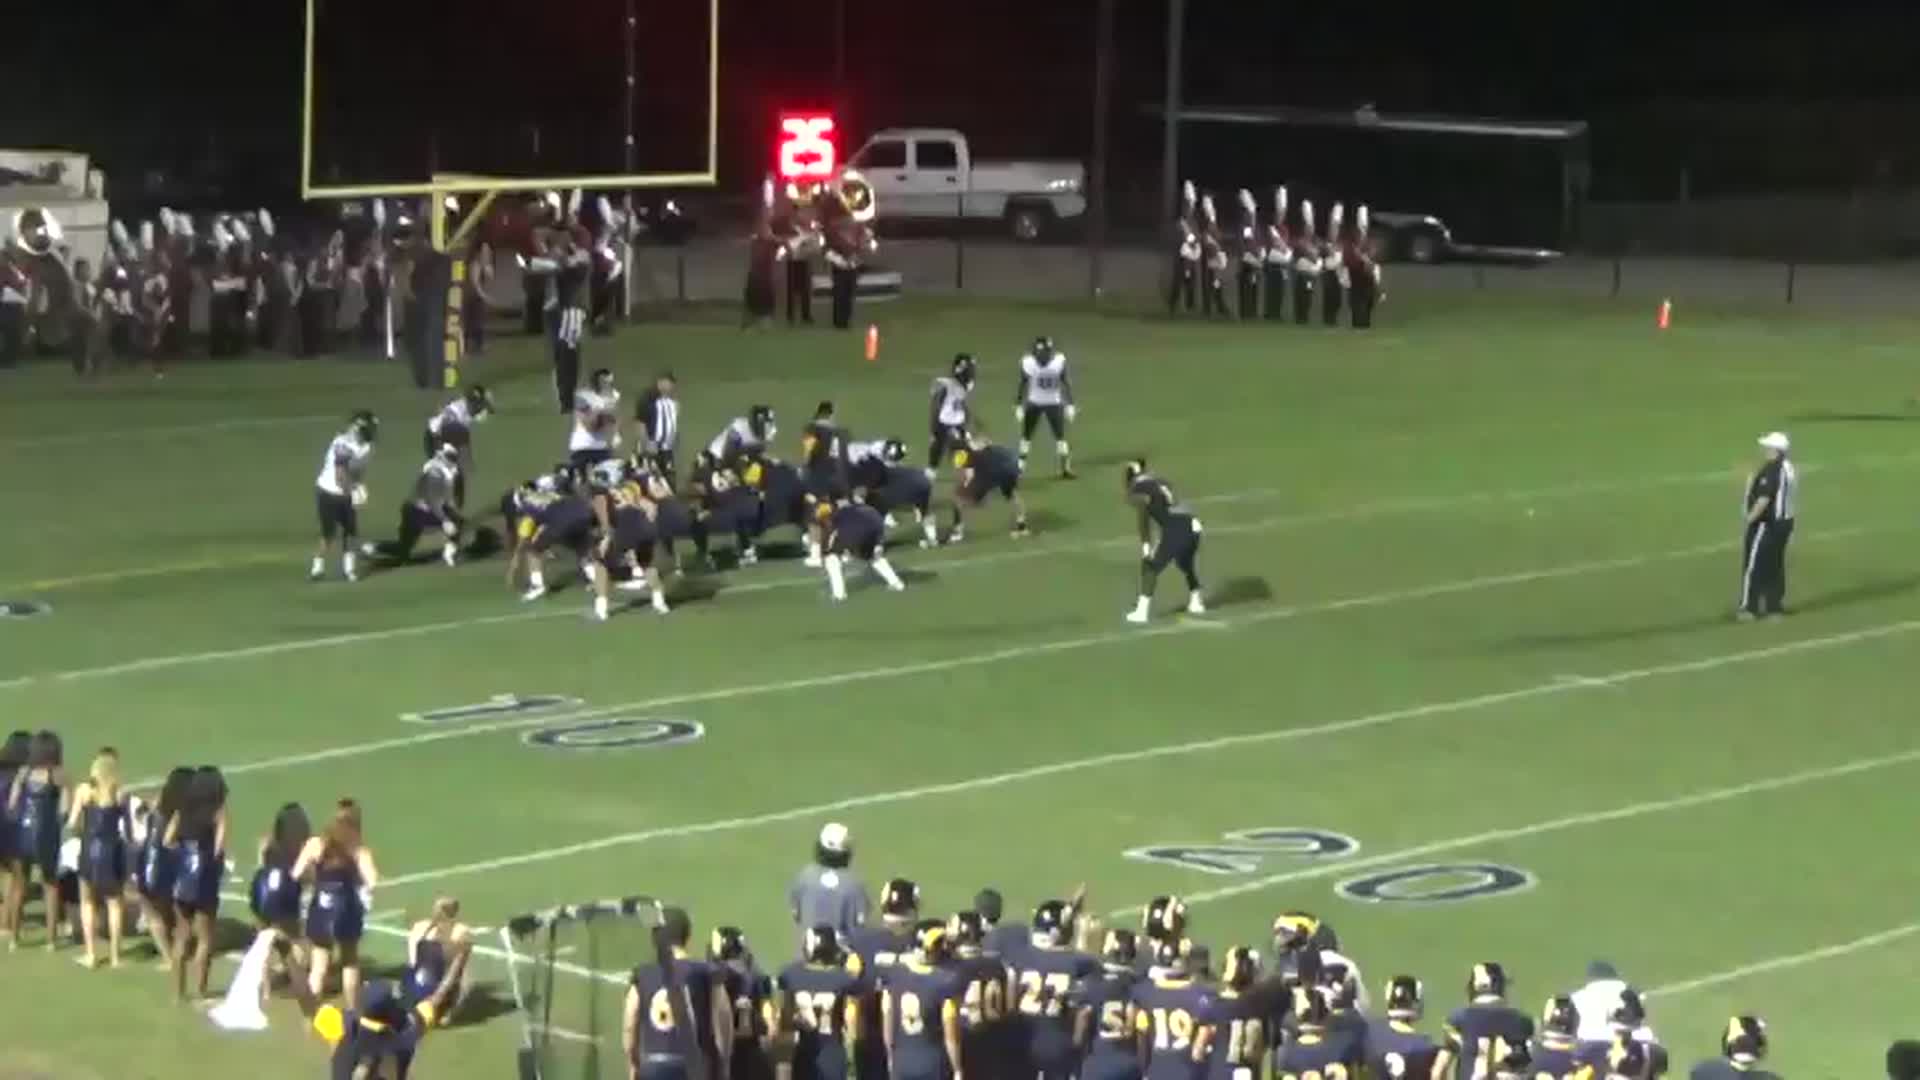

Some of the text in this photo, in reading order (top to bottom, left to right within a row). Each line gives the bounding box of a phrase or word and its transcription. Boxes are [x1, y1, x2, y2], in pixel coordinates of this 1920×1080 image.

[649, 986, 676, 1032] 6
[1019, 970, 1071, 1017] 27
[1152, 1007, 1194, 1050] 19
